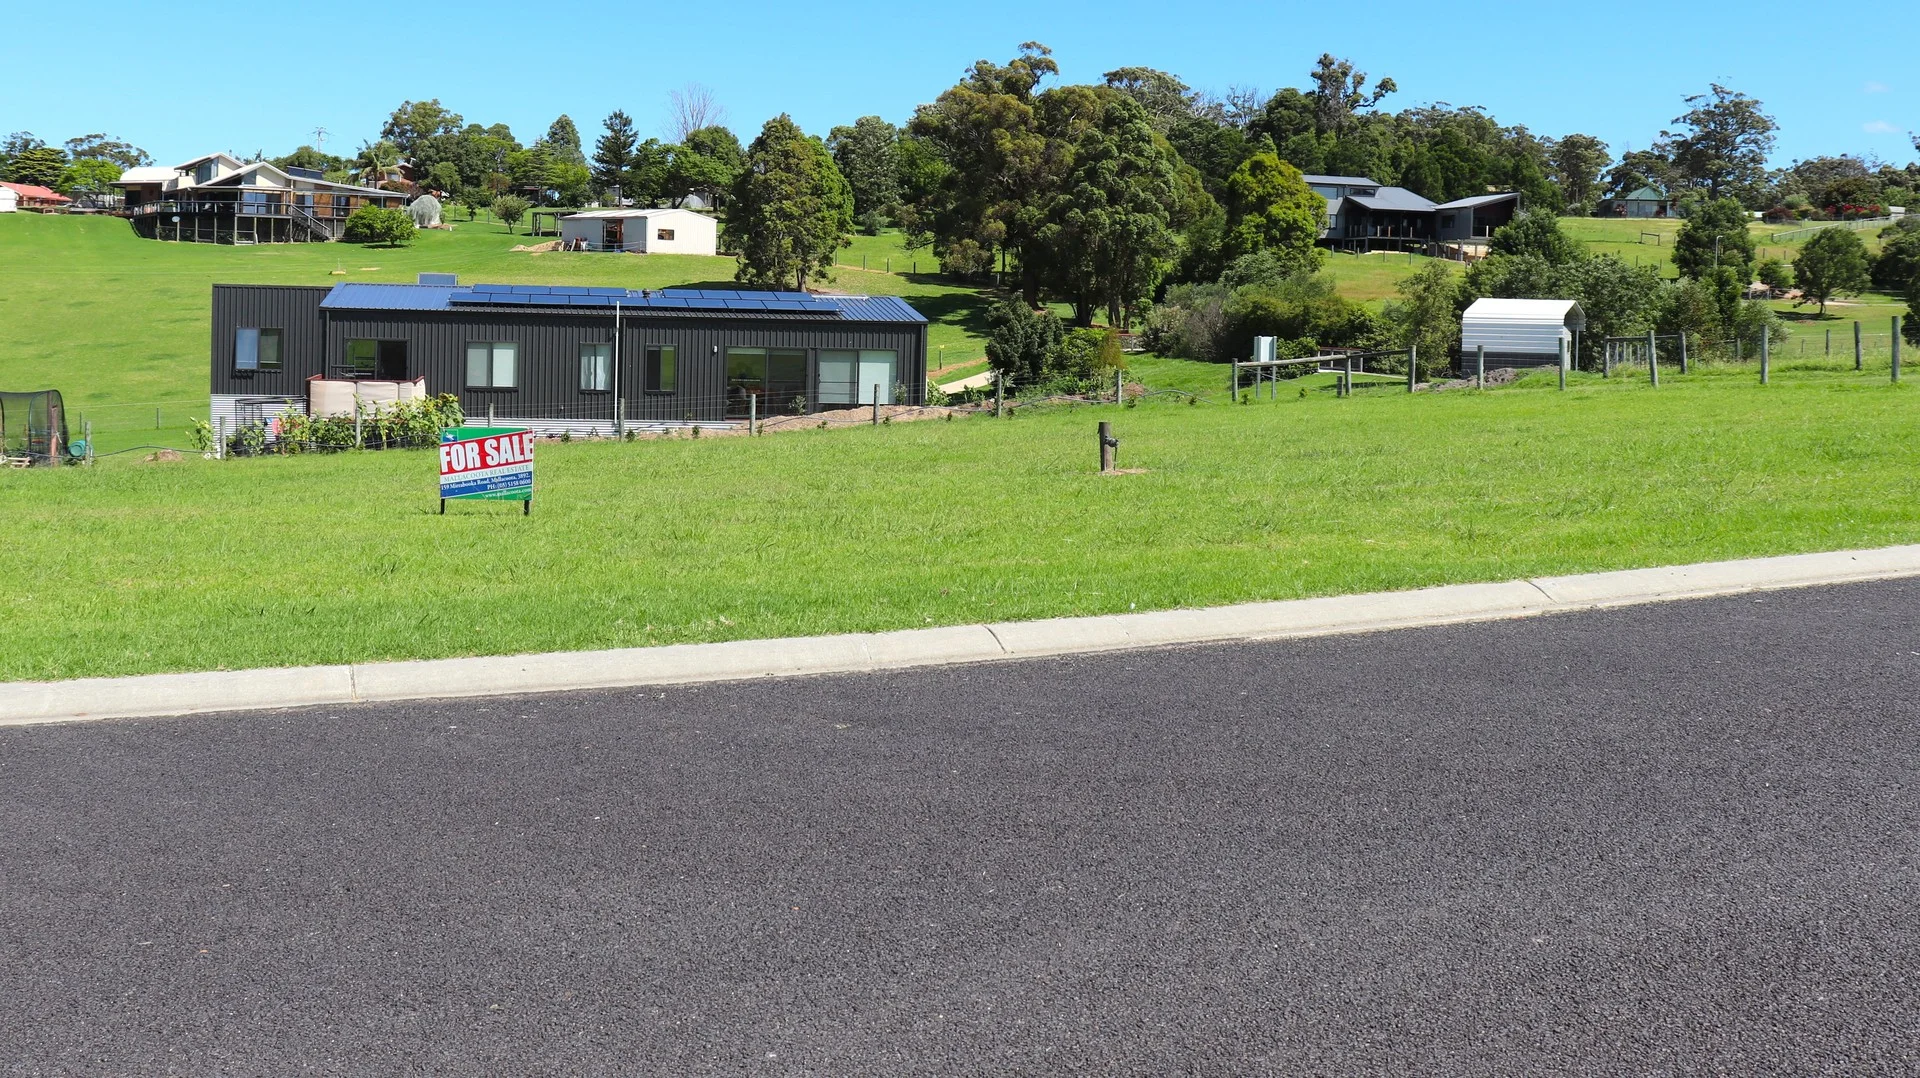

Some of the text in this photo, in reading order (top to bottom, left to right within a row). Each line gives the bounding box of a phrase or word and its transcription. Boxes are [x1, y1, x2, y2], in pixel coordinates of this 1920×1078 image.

[440, 433, 533, 473] FOR SALE
[444, 464, 529, 482] MALLACOOTA REAL ESTATE
